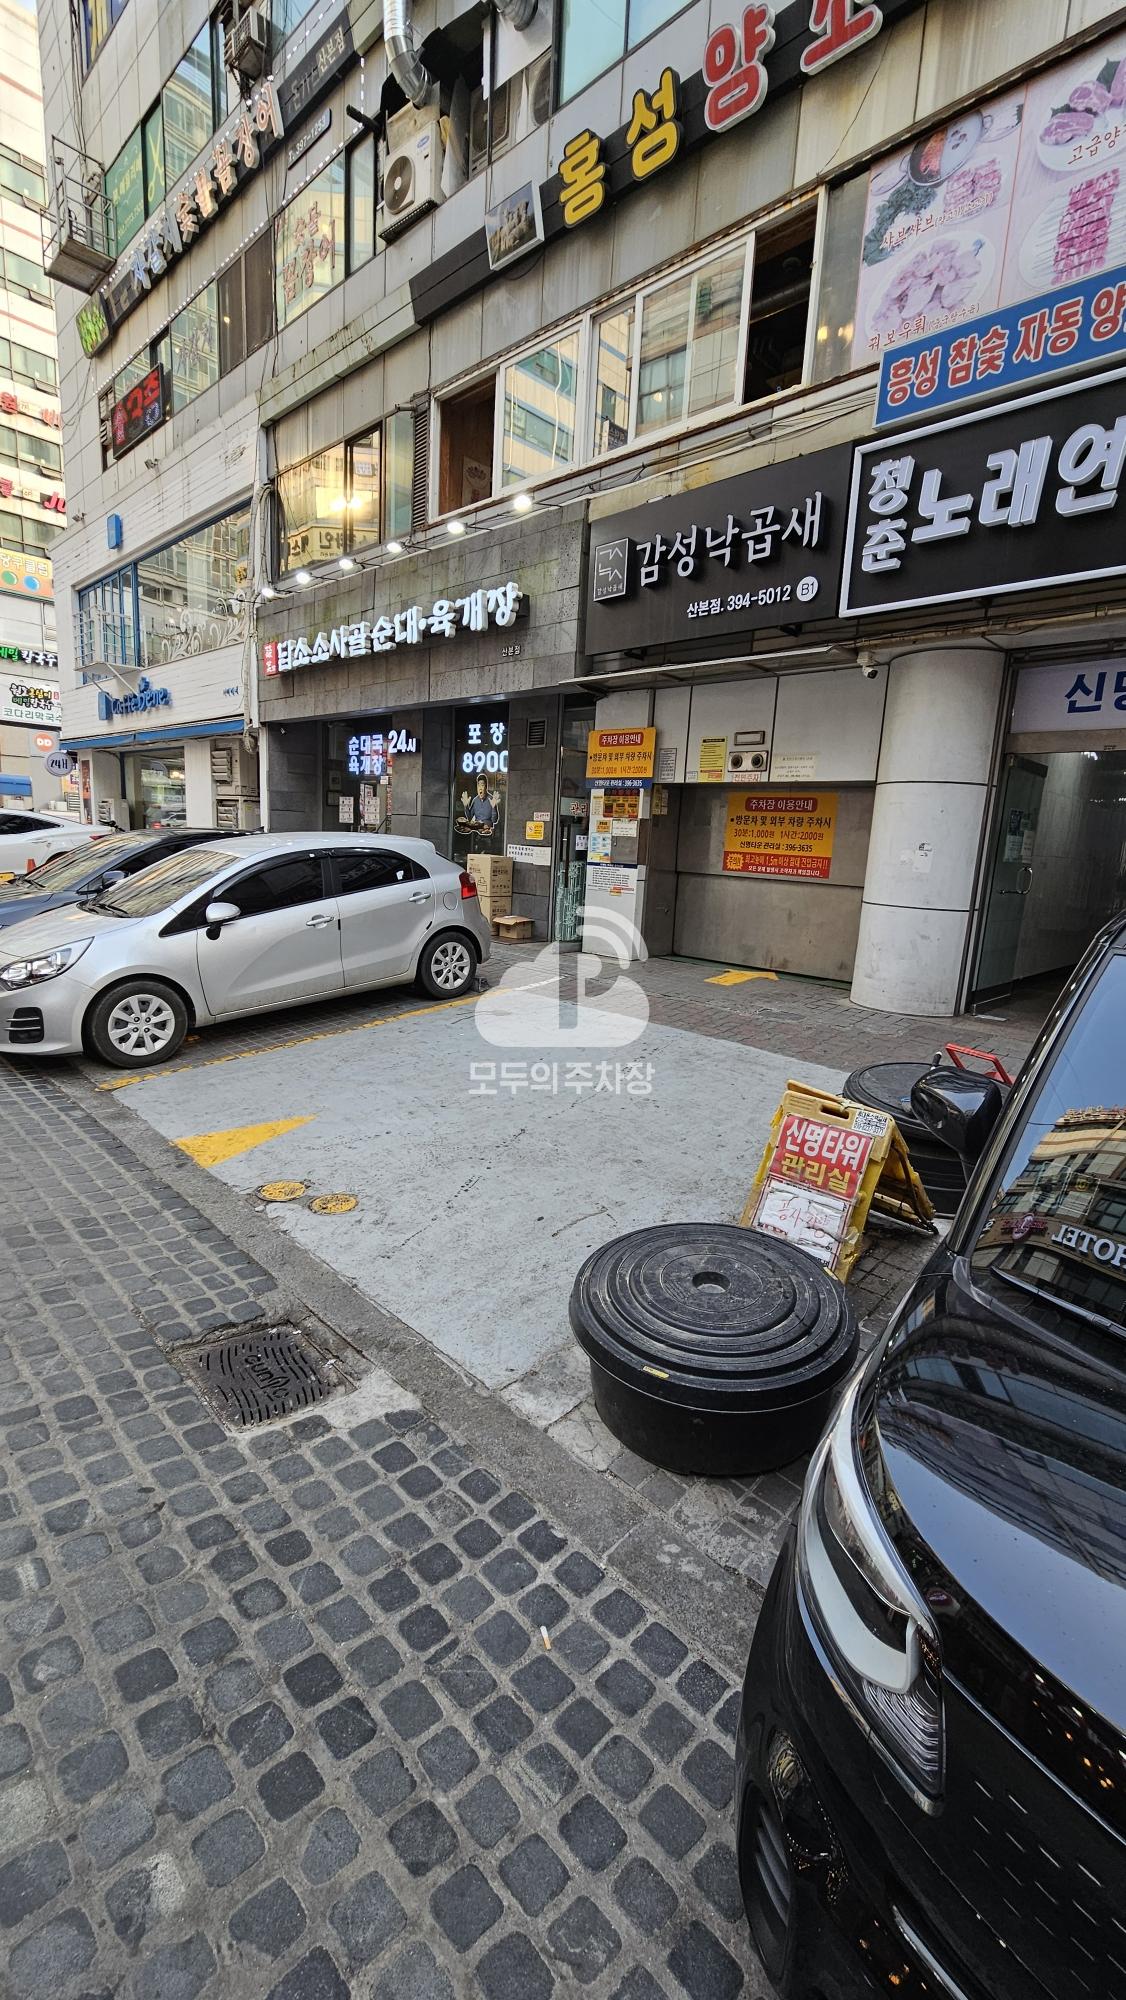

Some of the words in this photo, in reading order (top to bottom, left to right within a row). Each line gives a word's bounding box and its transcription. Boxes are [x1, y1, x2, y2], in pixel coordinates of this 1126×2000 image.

[559, 67, 682, 228] 홍성
[1068, 125, 1126, 165] 고급양
[887, 345, 942, 406] 흥성
[947, 324, 1009, 388] 참숯
[1013, 296, 1084, 363] 자동
[861, 454, 916, 574] 청춘
[636, 490, 827, 589] 감성낙곱새
[726, 584, 792, 612] 394-5012
[800, 580, 817, 598] B1
[21, 650, 57, 667] 칼국수
[348, 734, 384, 755] 순대국
[388, 729, 417, 754] 24시
[601, 734, 618, 745] 주차장
[619, 732, 642, 745] 이용안내
[348, 755, 385, 776] 육개장
[750, 799, 775, 810] 주차장
[777, 799, 813, 811] 이용안내
[735, 815, 757, 826] 방문차
[760, 815, 768, 826] 및
[769, 816, 786, 827] 외부
[788, 816, 804, 828] 차량
[807, 817, 831, 828] 주차시
[764, 842, 780, 850] 관리실
[786, 1119, 866, 1171] 신명타워
[782, 1153, 851, 1194] 관리실
